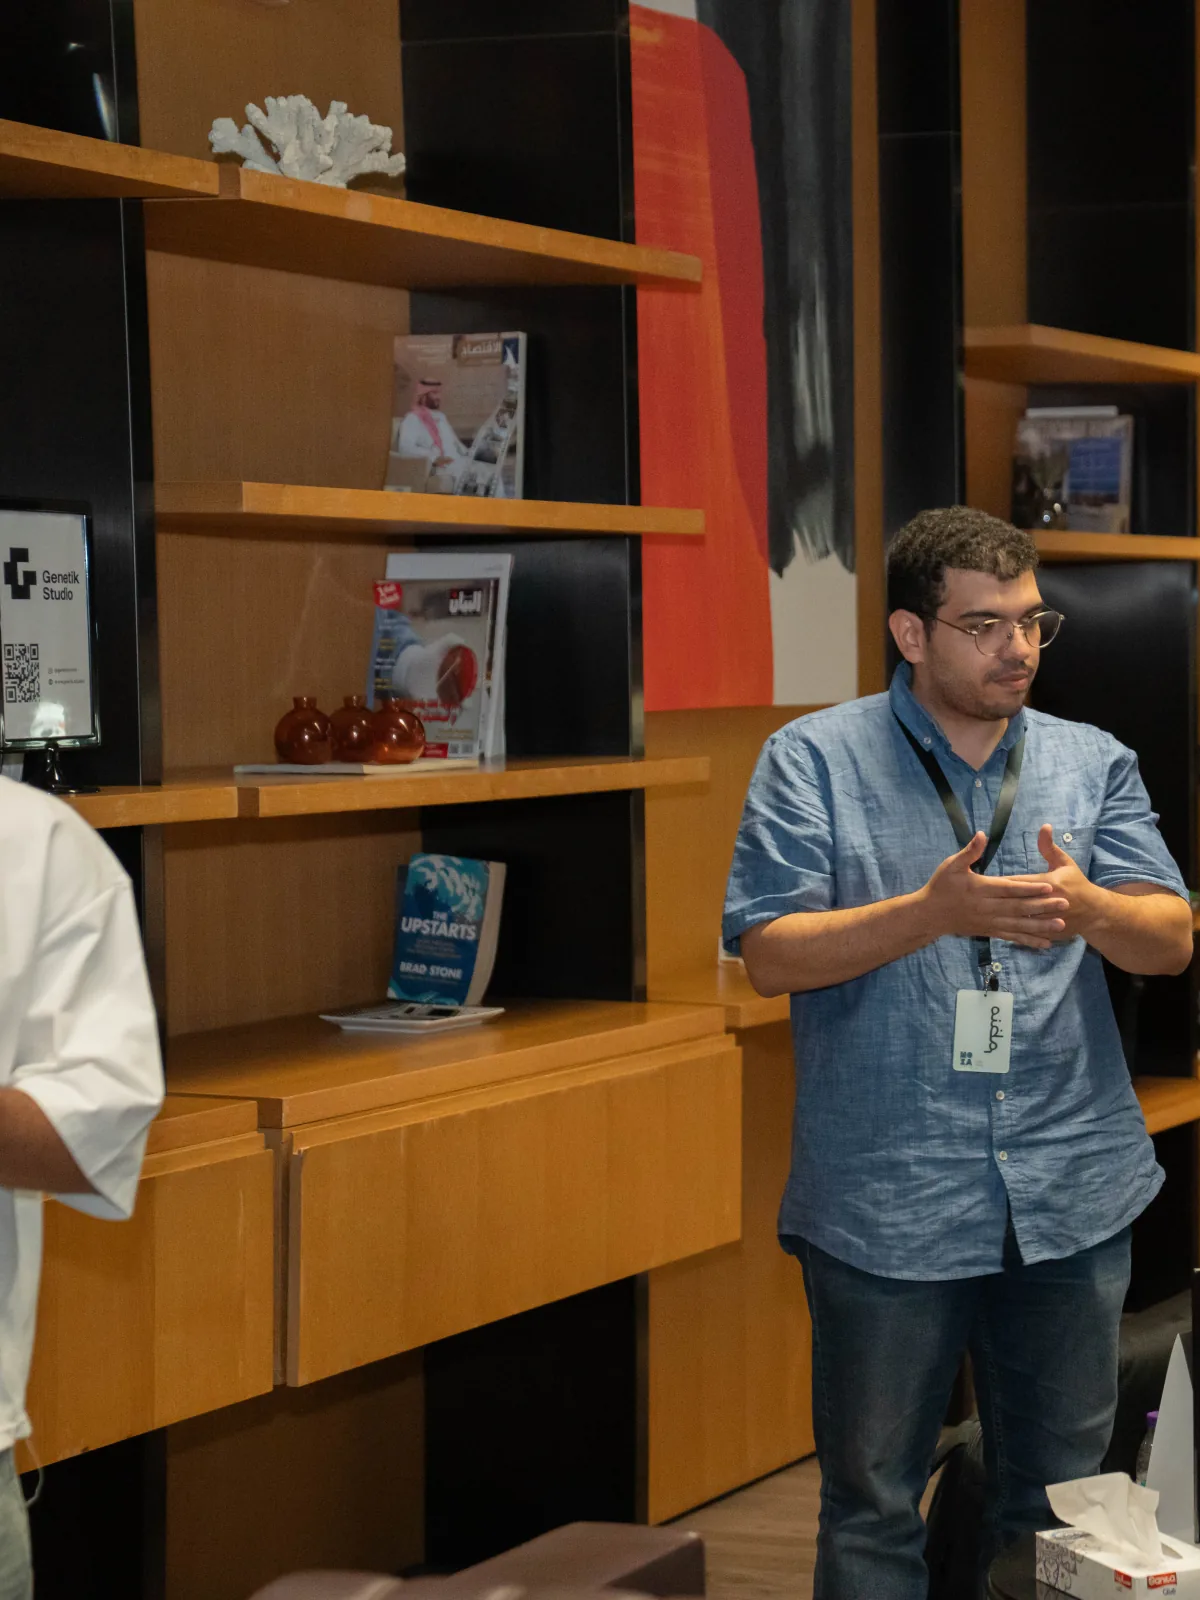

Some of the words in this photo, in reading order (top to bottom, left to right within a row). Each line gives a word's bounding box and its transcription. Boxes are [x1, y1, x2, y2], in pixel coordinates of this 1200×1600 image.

[42, 570, 80, 585] Genetik
[43, 586, 74, 601] Studio
[432, 910, 448, 921] THE
[401, 917, 477, 940] UPSTARTS
[399, 961, 427, 975] BRAD
[429, 965, 463, 980] STONE
